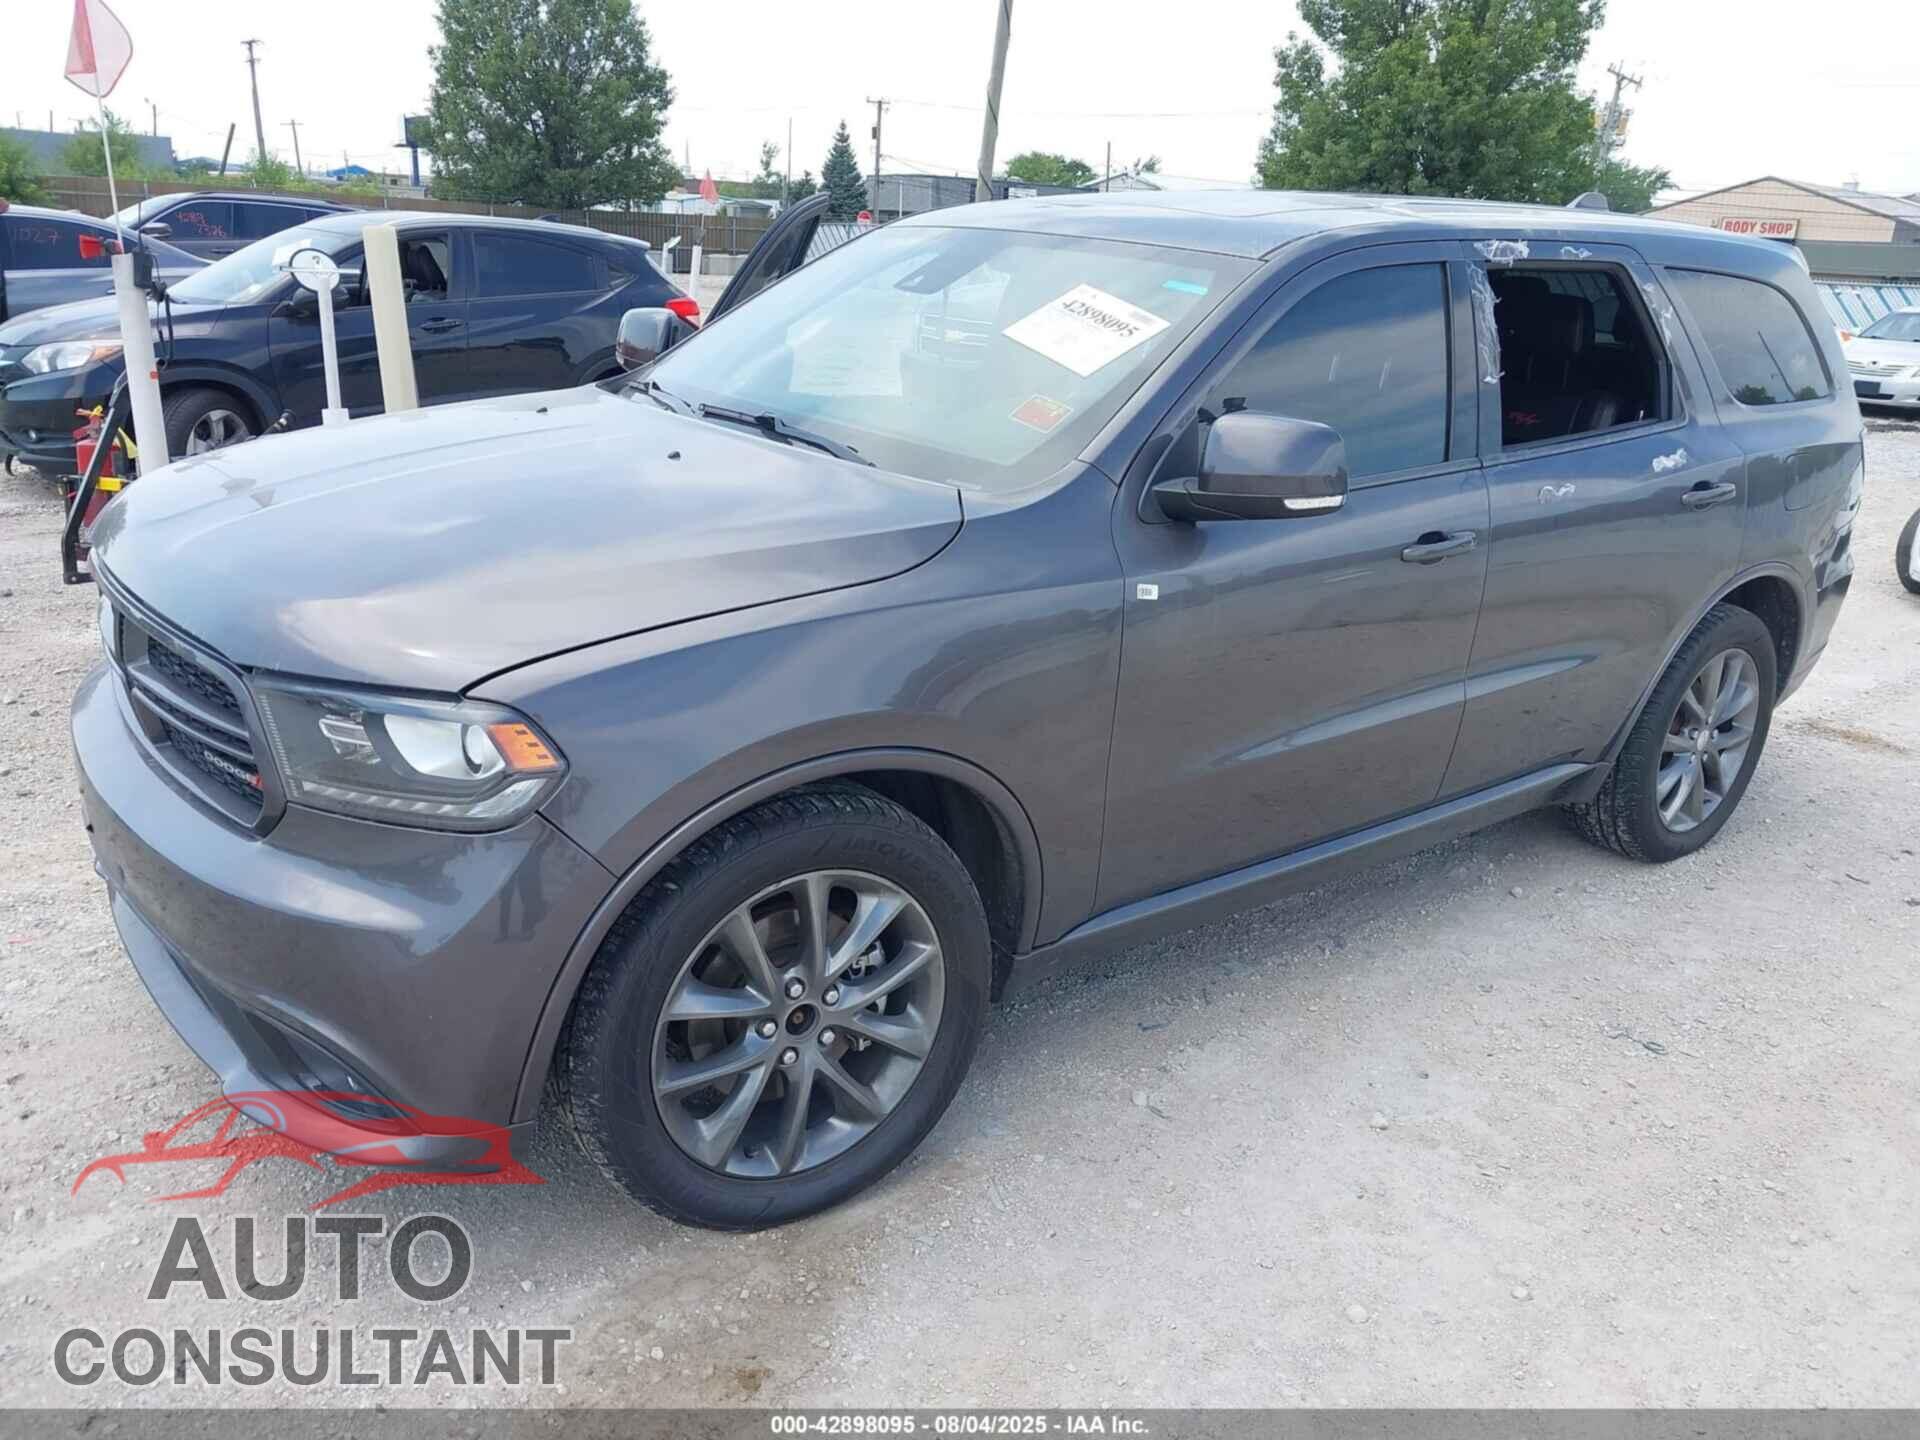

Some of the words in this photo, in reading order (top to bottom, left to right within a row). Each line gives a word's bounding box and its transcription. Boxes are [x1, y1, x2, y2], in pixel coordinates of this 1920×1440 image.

[1724, 221, 1758, 233] BODY
[1760, 222, 1793, 235] SHOP
[1062, 299, 1140, 337] 42898095
[204, 750, 256, 785] DODGE
